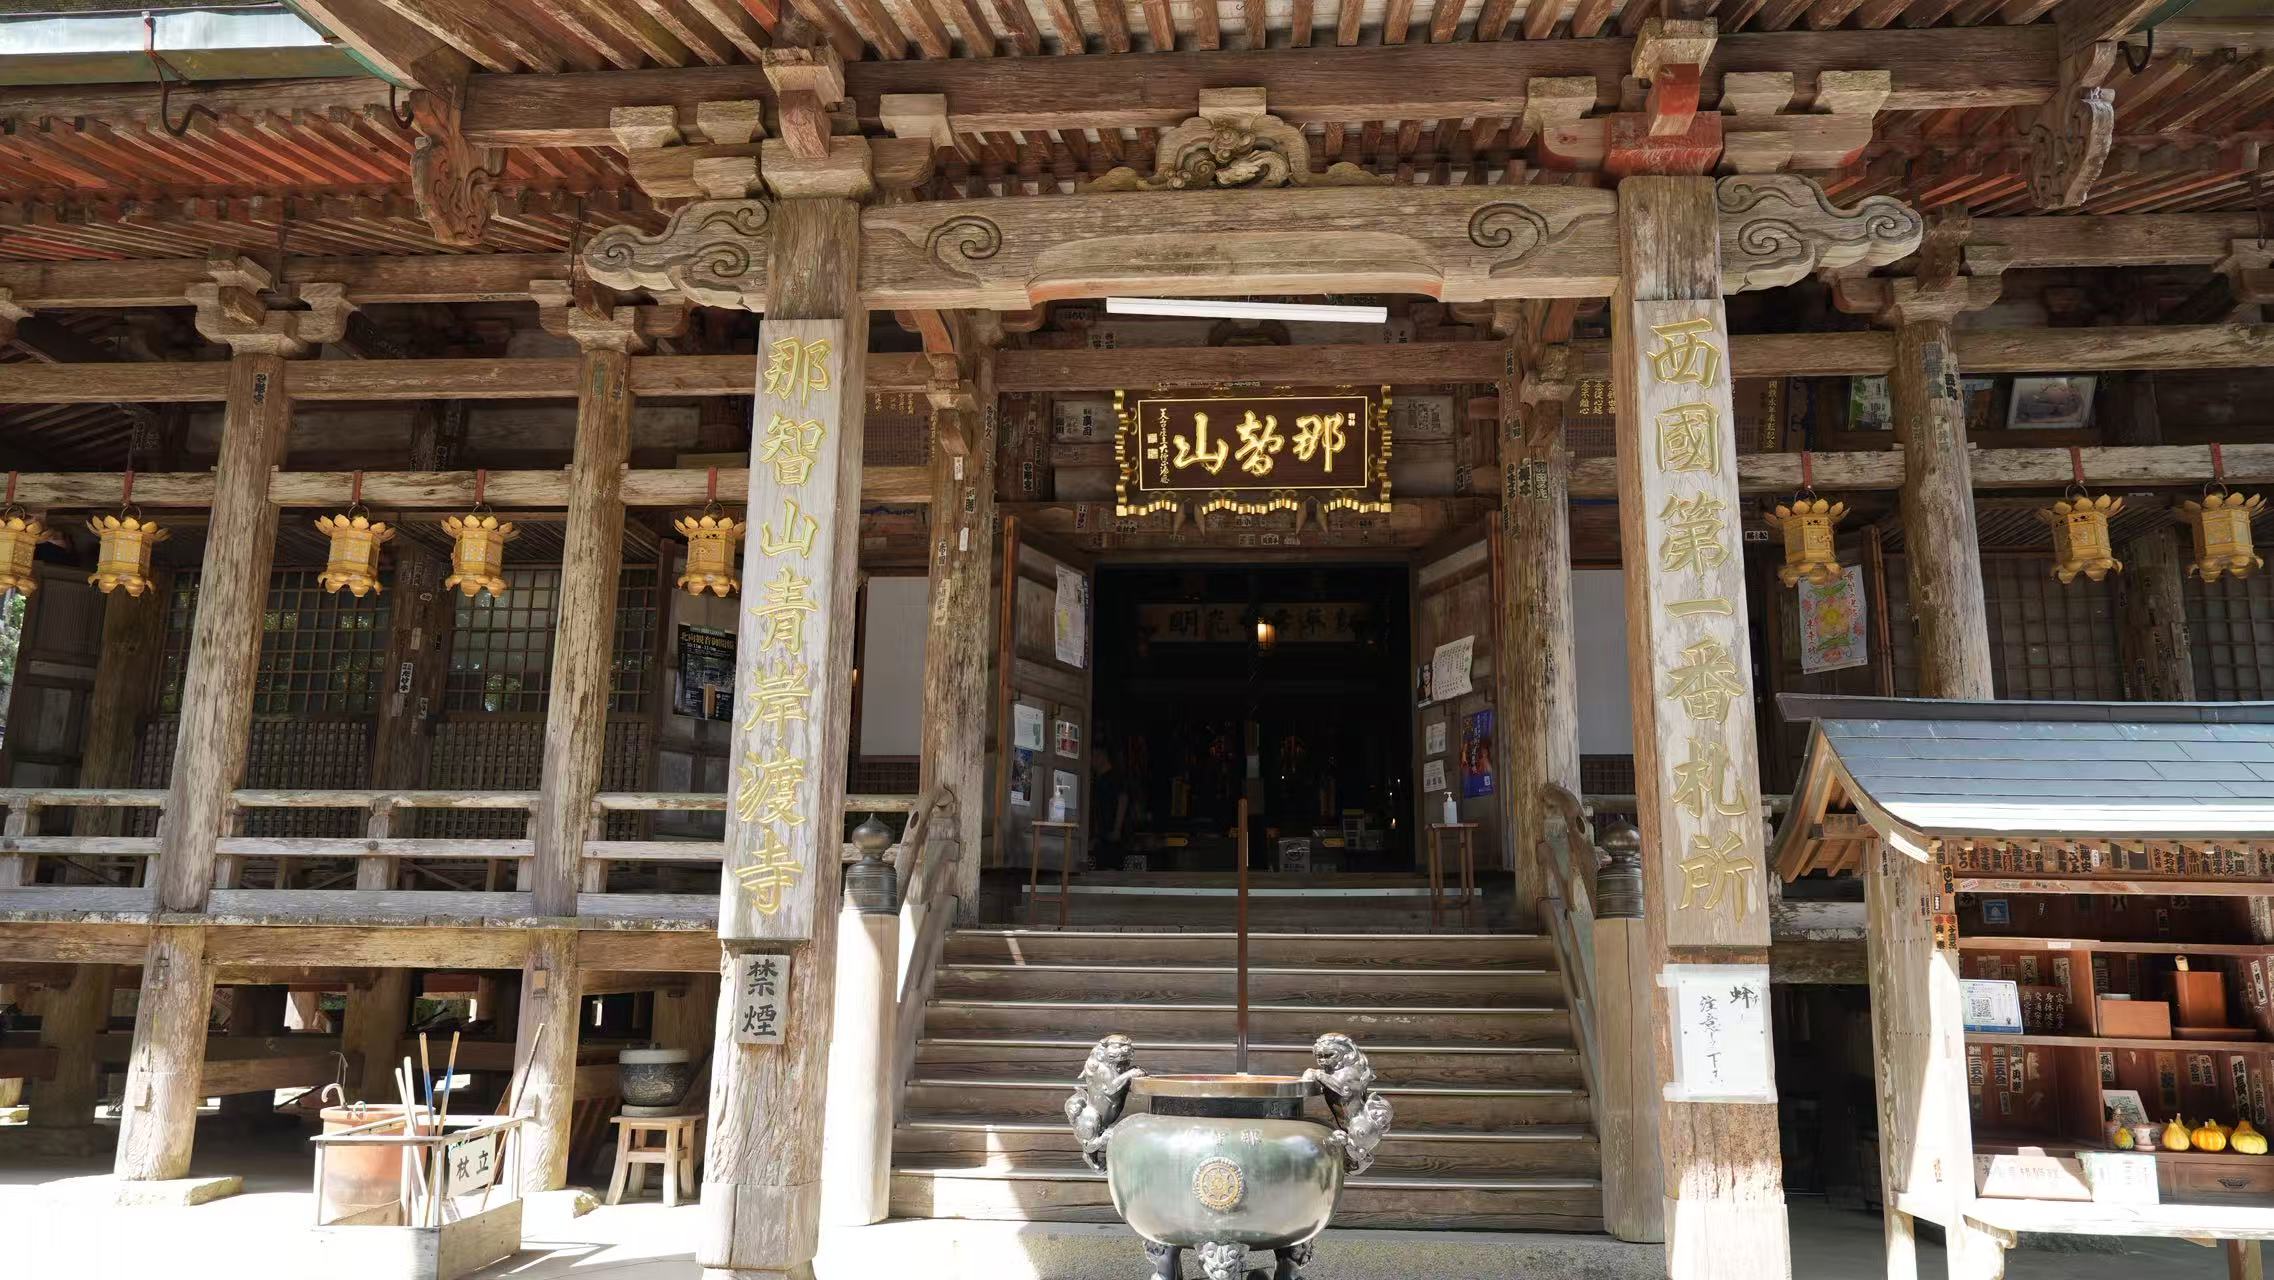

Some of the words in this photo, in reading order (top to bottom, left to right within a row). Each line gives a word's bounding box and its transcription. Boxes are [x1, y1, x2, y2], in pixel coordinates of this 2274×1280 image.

[735, 336, 833, 915] 那智山青岸渡寺
[1646, 317, 1754, 924] 西國第一番札所
[742, 958, 779, 1037] 禁煙
[456, 1149, 490, 1181] 杖立
